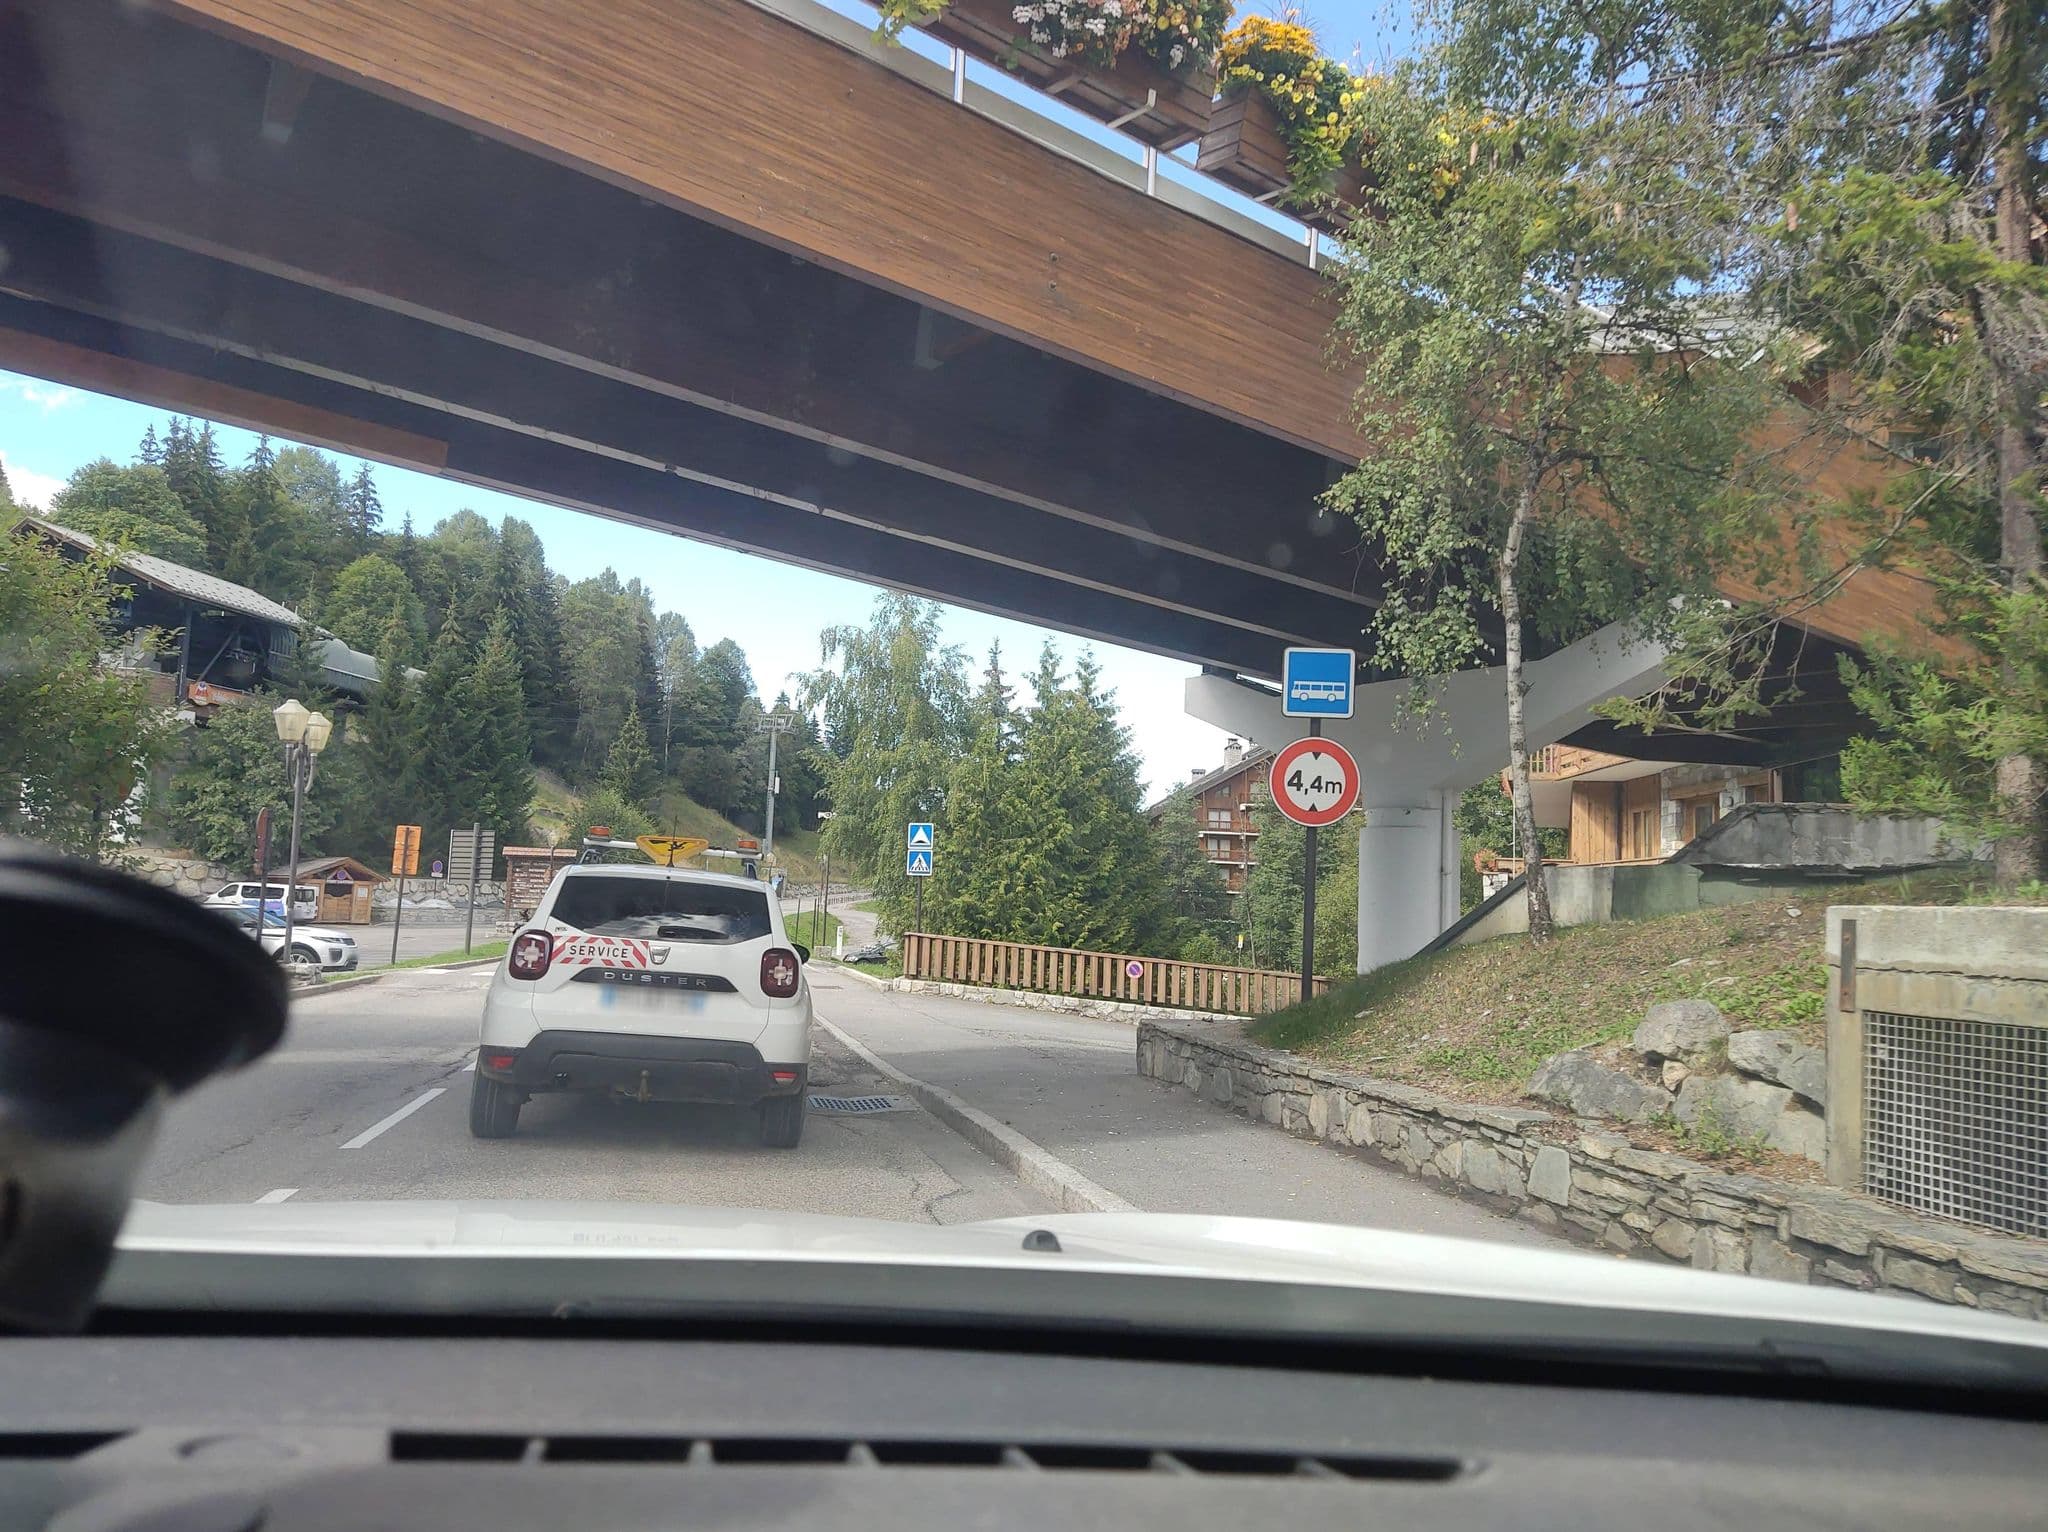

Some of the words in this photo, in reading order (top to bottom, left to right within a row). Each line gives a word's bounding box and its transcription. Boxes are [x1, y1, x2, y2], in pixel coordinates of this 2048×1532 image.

[1287, 769, 1343, 795] 4,4m
[569, 945, 629, 959] SERVICE
[604, 971, 707, 987] DUSTER
